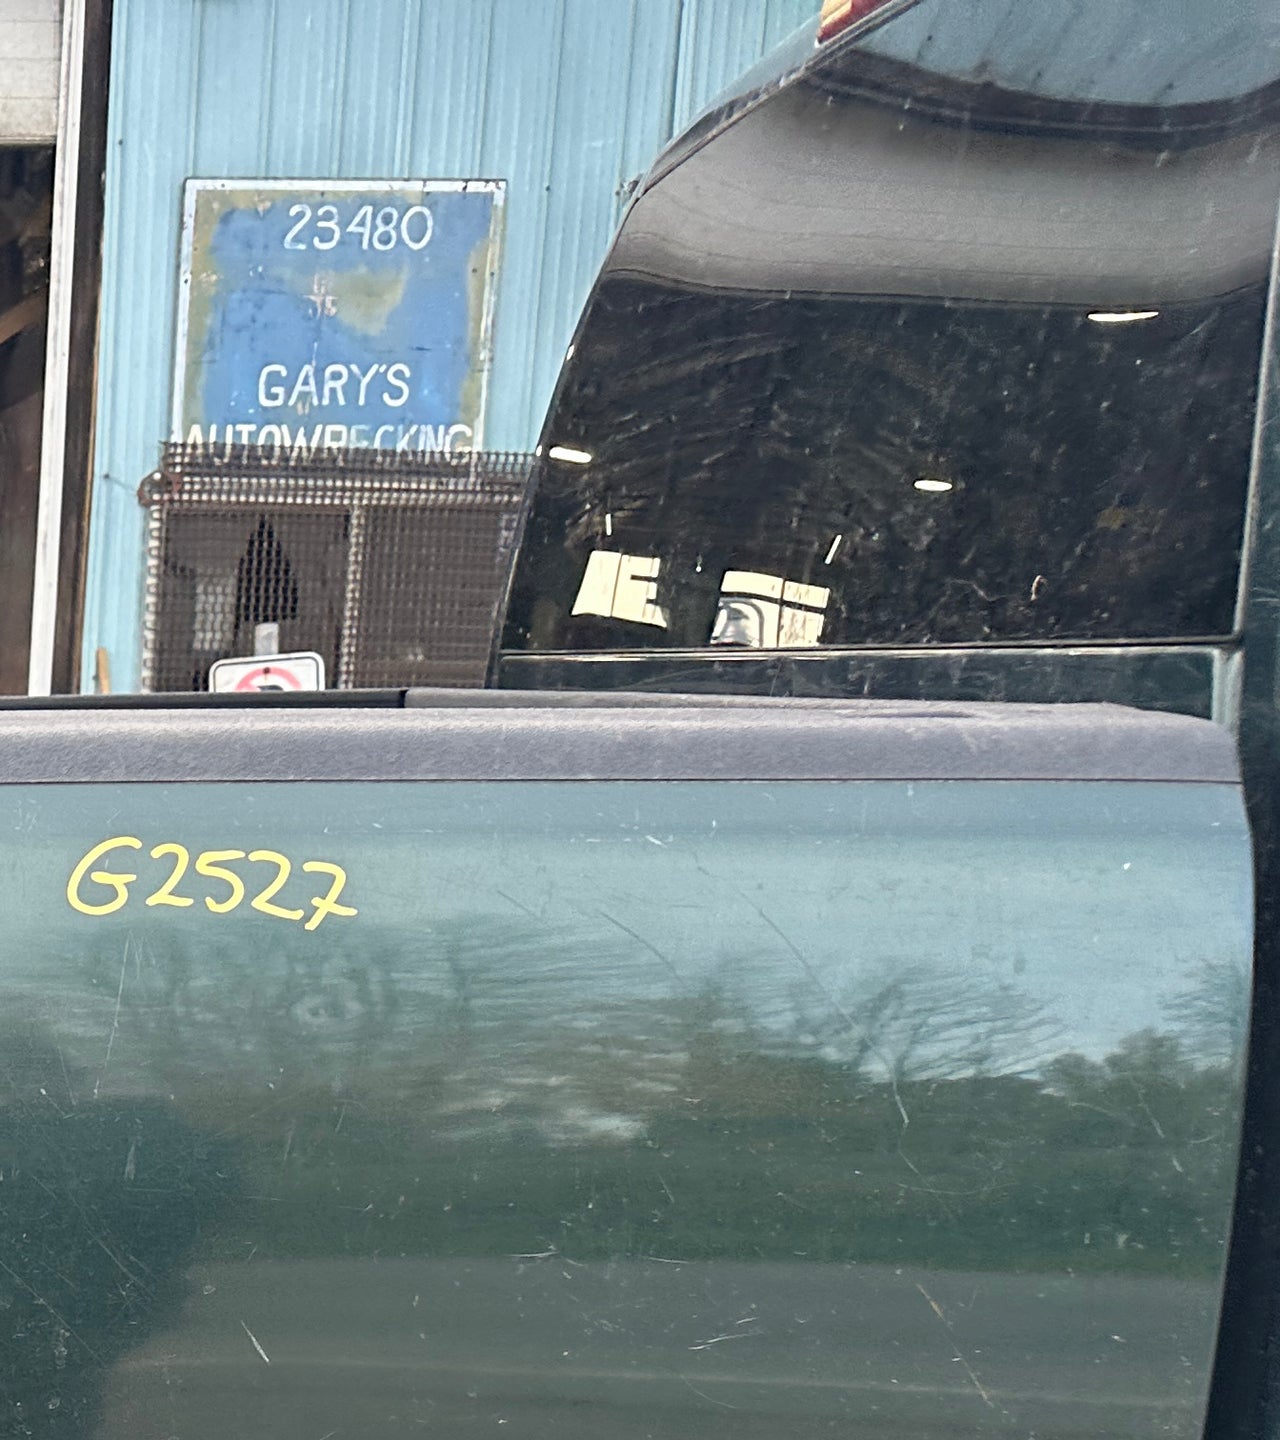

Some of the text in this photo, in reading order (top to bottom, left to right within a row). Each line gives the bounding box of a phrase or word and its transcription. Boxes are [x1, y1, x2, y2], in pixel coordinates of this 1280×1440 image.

[284, 204, 435, 251] 23480
[259, 363, 411, 408] GARY'S
[66, 836, 358, 931] G2527
